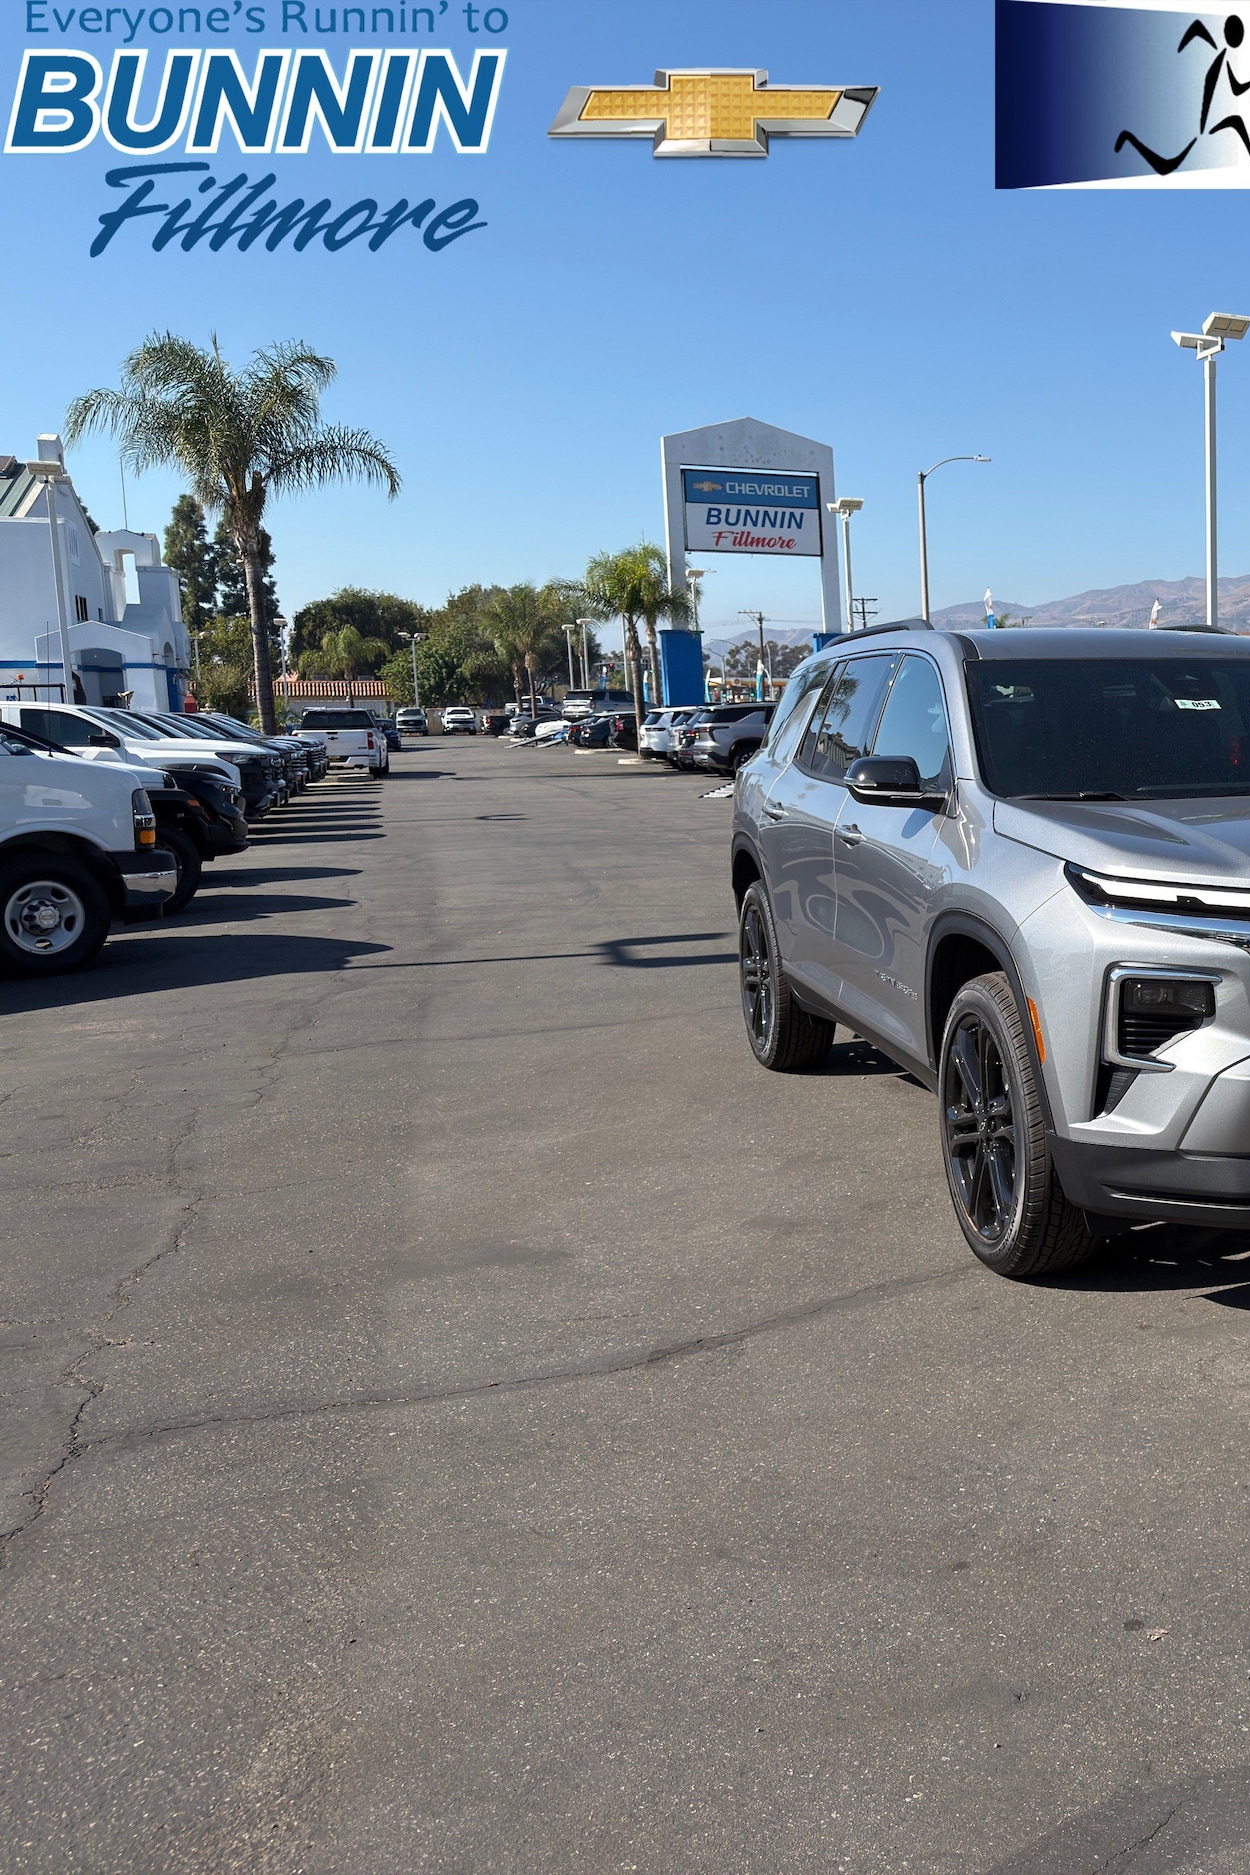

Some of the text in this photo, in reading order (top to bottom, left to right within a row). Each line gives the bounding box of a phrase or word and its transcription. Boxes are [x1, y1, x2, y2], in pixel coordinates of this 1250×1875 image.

[726, 482, 810, 497] CHEVROLET
[706, 507, 804, 529] BUNNIN
[712, 531, 797, 549] Fillmore
